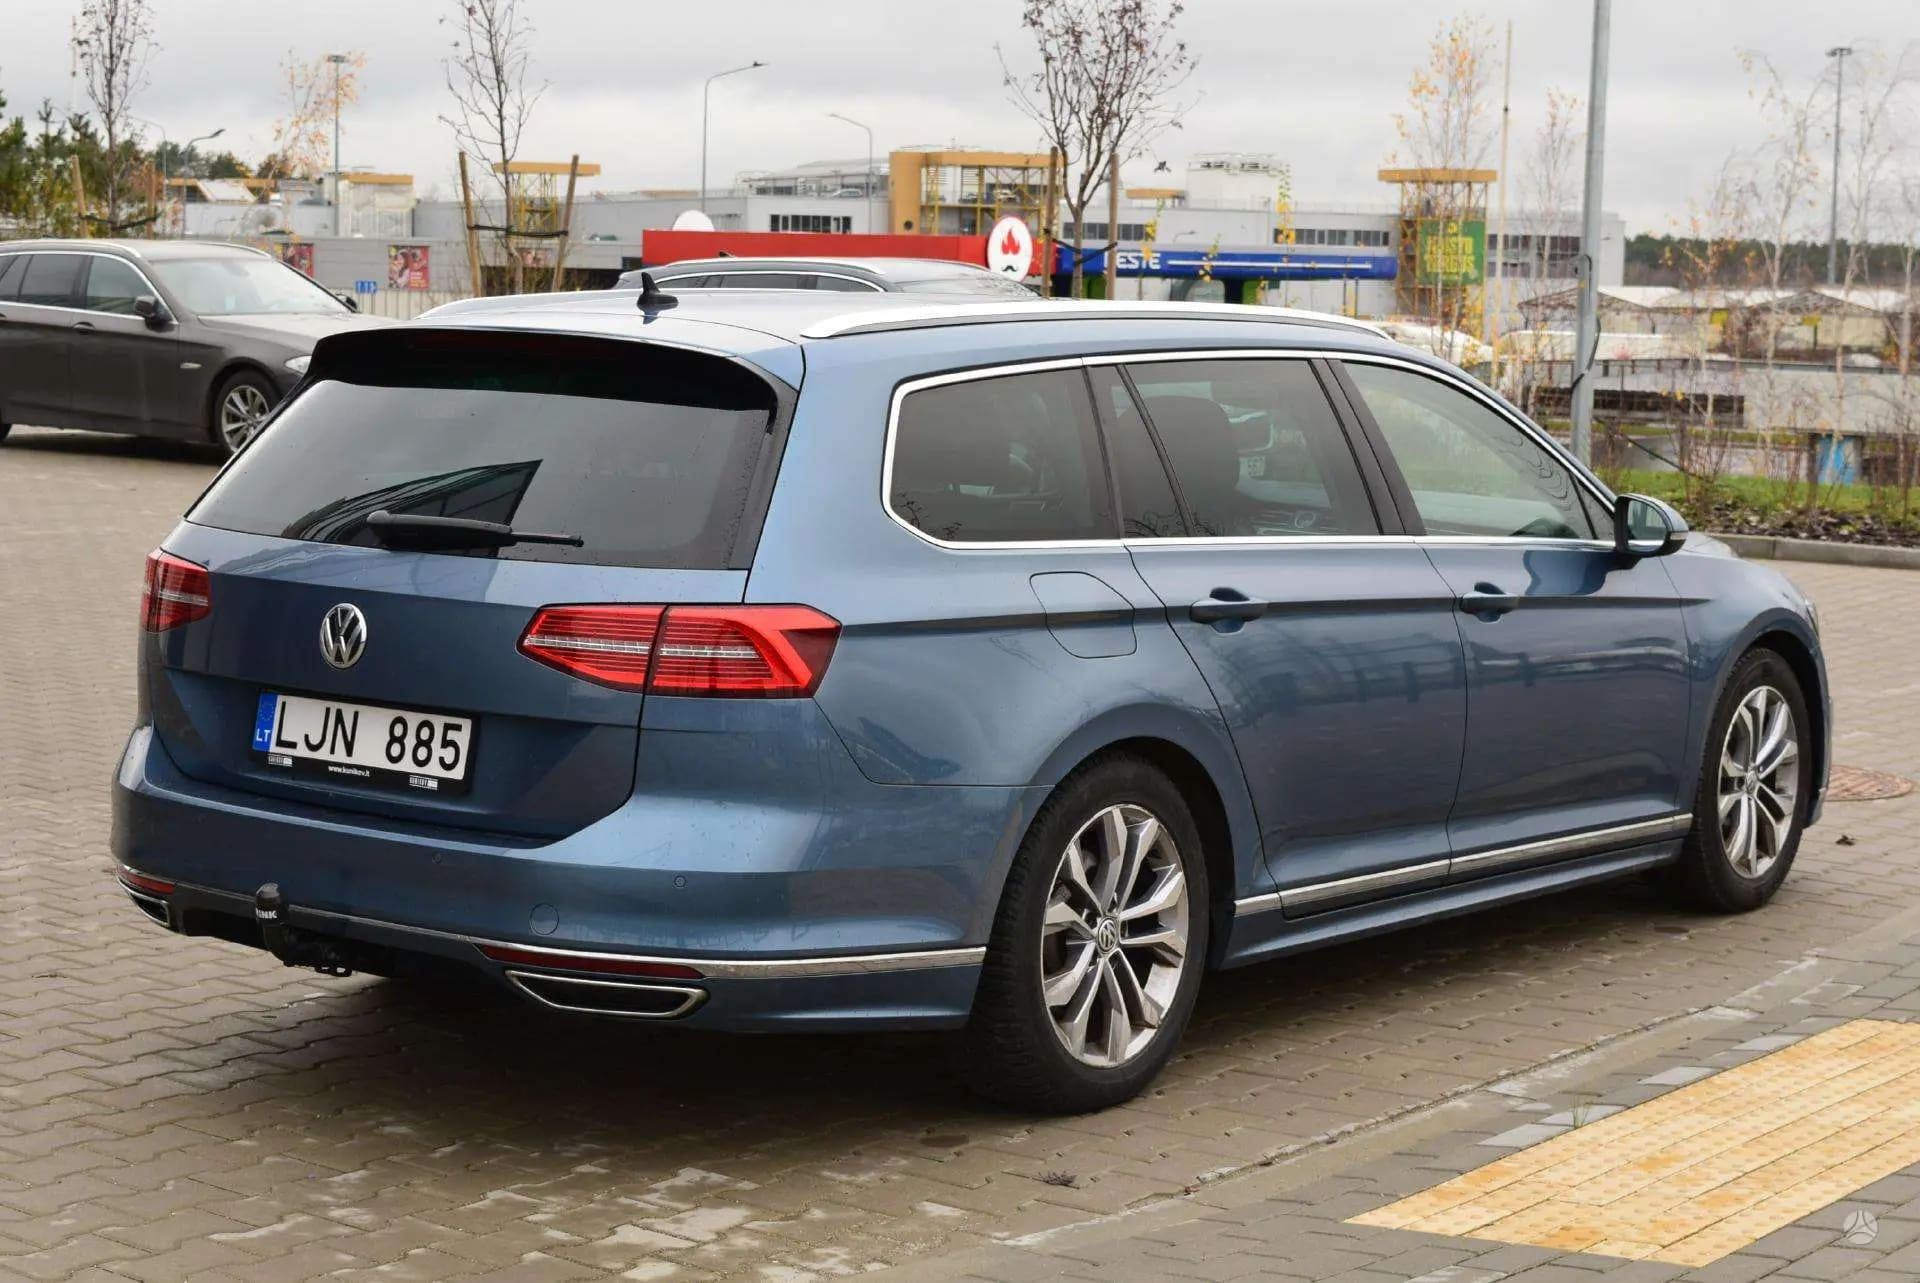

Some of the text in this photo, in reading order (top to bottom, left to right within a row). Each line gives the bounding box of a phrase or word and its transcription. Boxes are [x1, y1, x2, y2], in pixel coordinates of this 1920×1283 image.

[255, 727, 272, 742] LT
[275, 700, 463, 772] LJN 885
